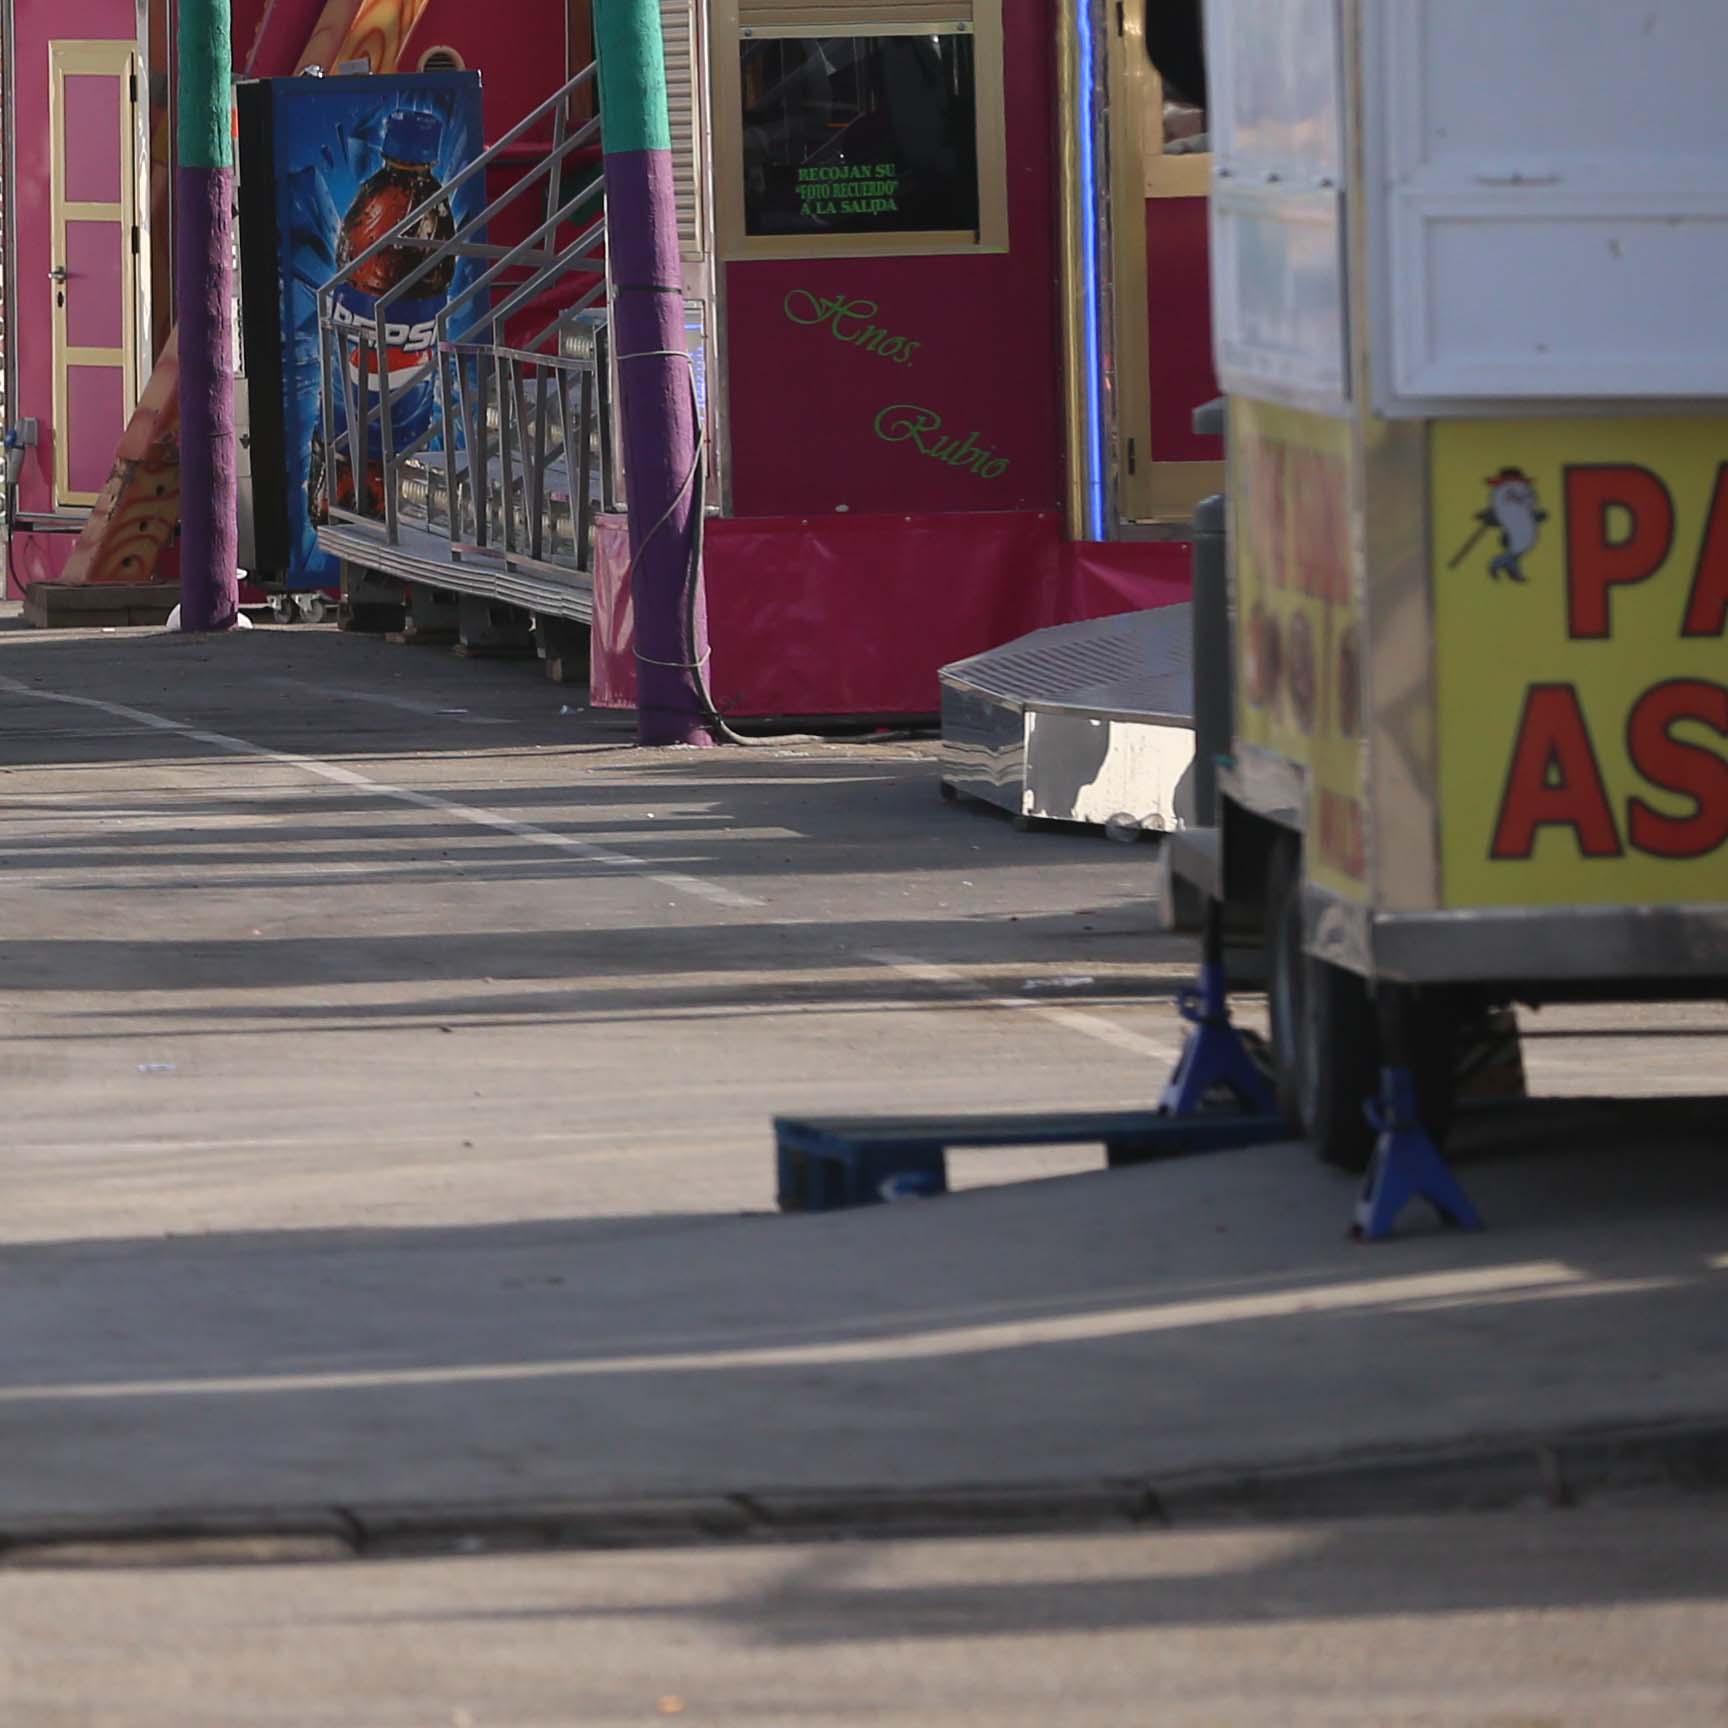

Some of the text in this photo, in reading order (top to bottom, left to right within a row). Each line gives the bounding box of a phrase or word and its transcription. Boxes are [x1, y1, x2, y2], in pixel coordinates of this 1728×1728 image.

[798, 163, 896, 181] RECOJAN SU
[800, 198, 898, 215] A LA SALIDA
[873, 403, 1011, 479] Rubio
